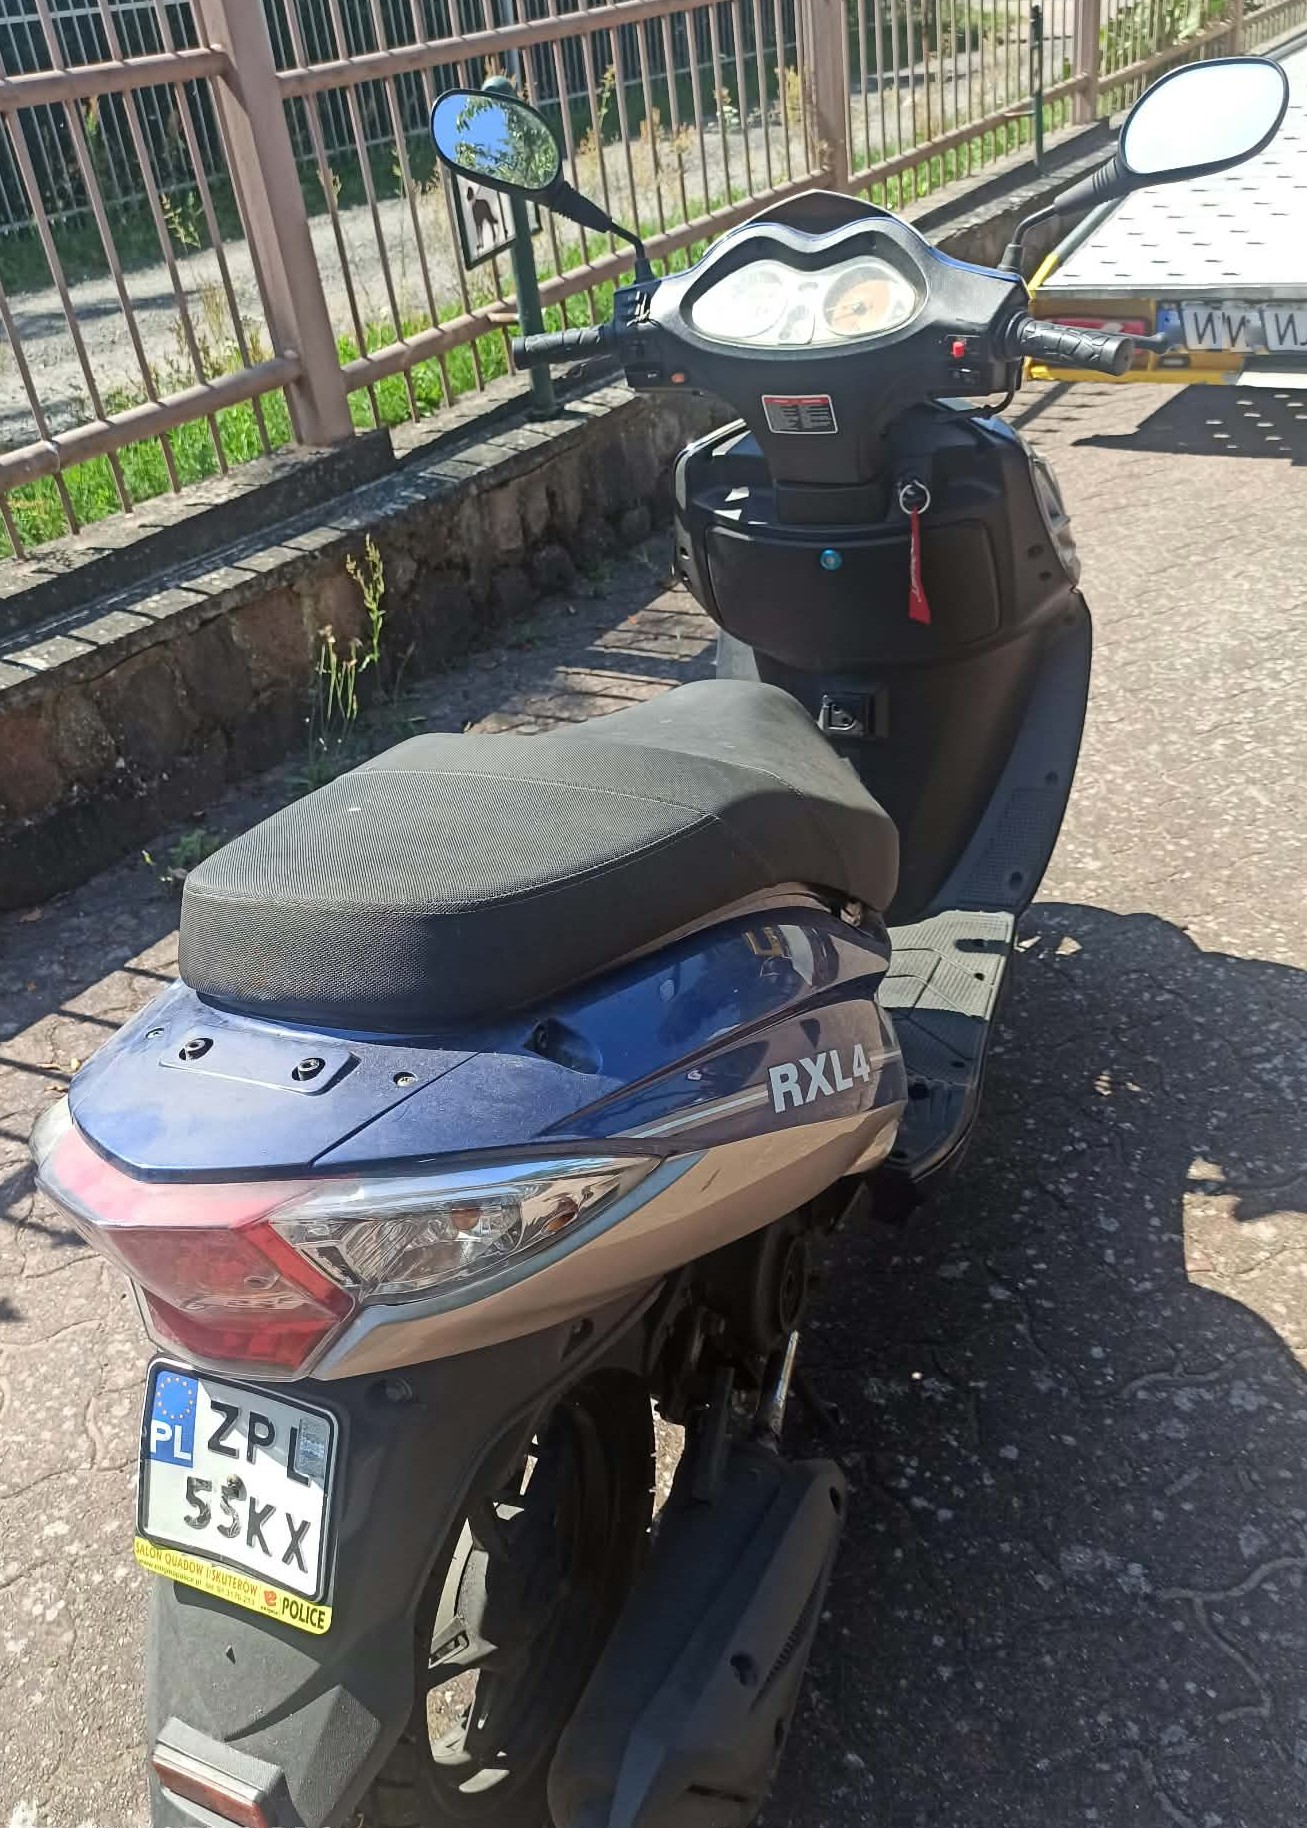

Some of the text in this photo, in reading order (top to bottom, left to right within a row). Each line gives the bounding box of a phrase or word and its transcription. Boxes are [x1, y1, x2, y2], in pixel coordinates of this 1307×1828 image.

[768, 1043, 870, 1114] RXL4
[150, 1419, 192, 1460] PL
[207, 1400, 312, 1487] ZPL
[136, 1542, 162, 1561] SALON
[282, 1597, 326, 1630] POLICE
